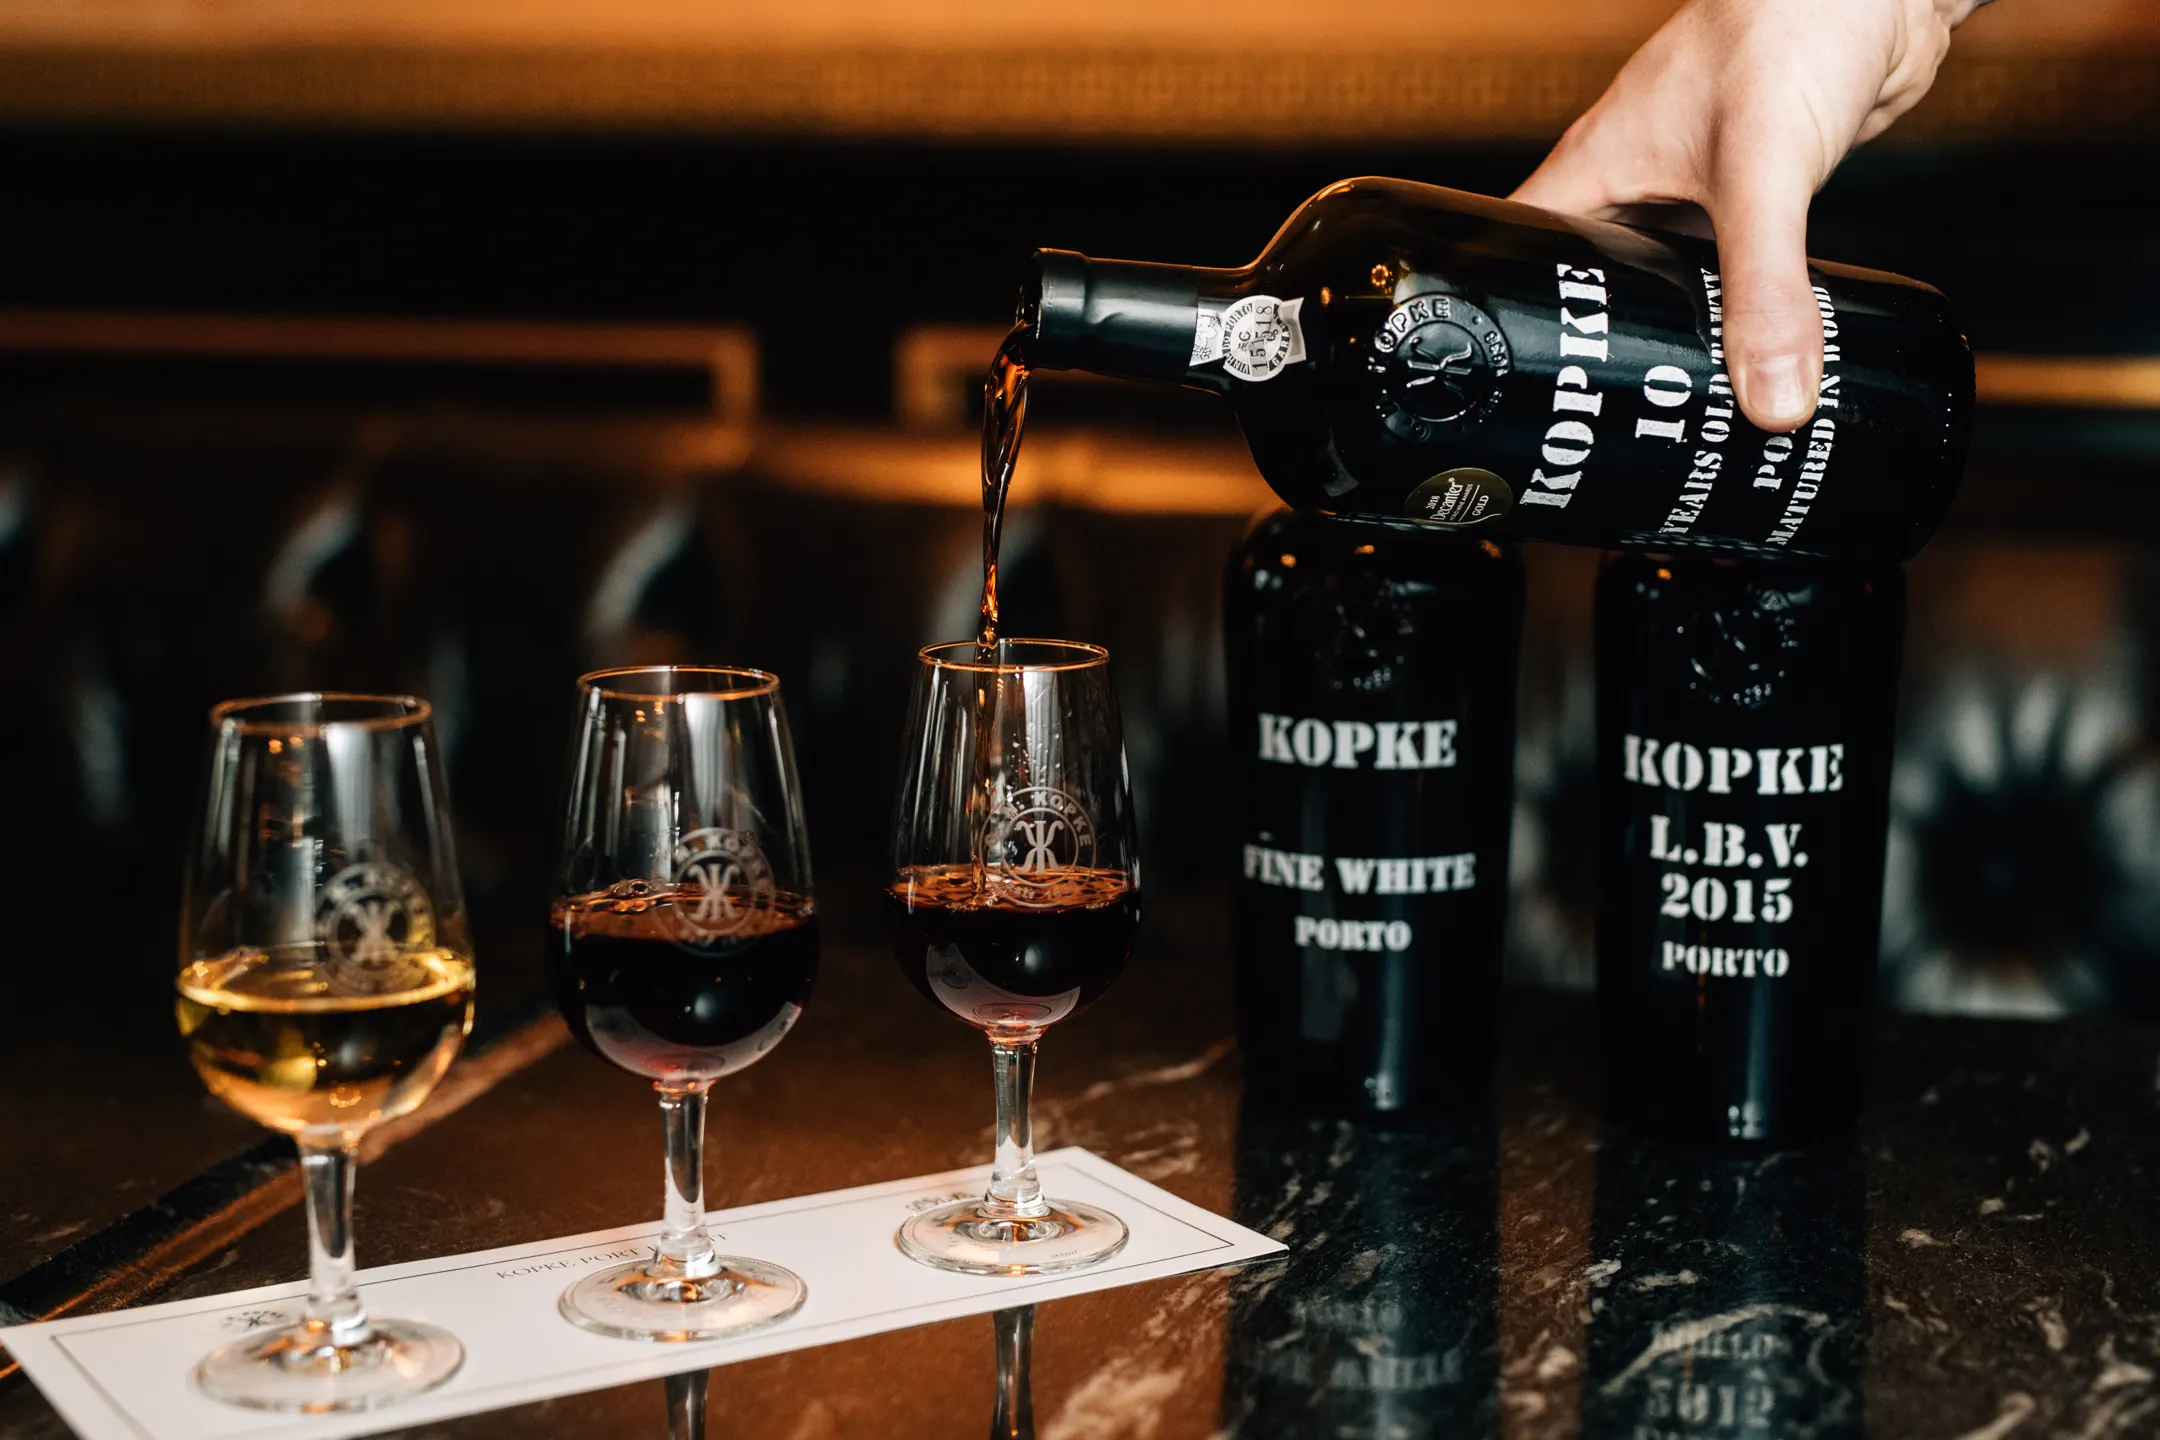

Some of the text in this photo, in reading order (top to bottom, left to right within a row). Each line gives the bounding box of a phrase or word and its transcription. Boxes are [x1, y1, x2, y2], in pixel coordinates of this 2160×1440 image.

[1225, 303, 1252, 331] PORTO
[1226, 353, 1251, 376] VINH
[1520, 263, 1609, 509] KOPKE
[1634, 364, 1693, 444] 10
[1658, 450, 1723, 534] YEARS
[1701, 373, 1735, 443] OLD
[1425, 495, 1441, 510] 2018
[1471, 494, 1490, 517] GOLD
[1765, 418, 1836, 546] MATURED
[1258, 713, 1458, 770] KOPKE
[1623, 734, 1845, 795] KOPKE
[1033, 791, 1092, 847] KOPKE
[1650, 814, 1809, 869] L.B.V.
[1244, 844, 1476, 895] FINE WHITE
[1660, 872, 1794, 924] 2015
[1294, 915, 1412, 951] PORTO
[1661, 940, 1790, 978] PORTO
[496, 1247, 639, 1280] KOPKE PORT
